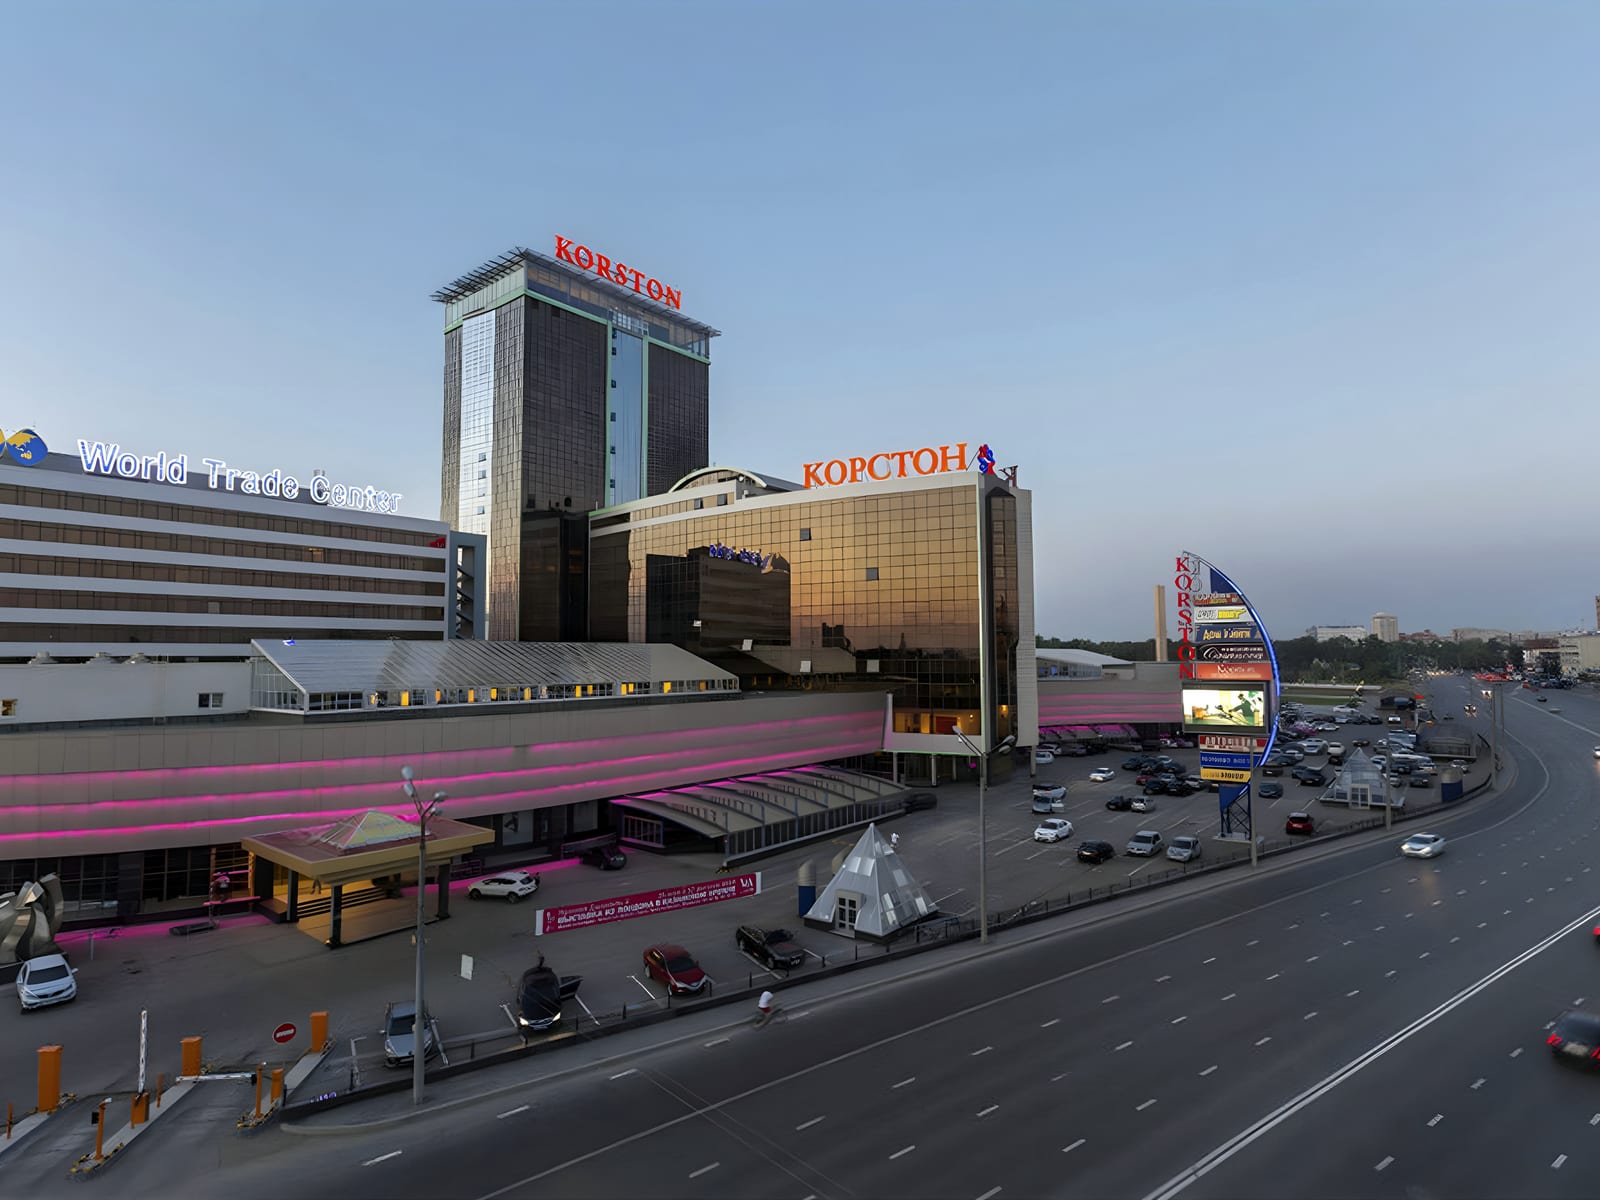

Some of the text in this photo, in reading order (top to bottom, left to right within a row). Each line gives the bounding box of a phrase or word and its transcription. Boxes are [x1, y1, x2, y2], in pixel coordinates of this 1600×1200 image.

[555, 233, 682, 310] KORSTON
[76, 438, 403, 514] World Trade Center
[803, 443, 968, 489] КОРСТОН
[1175, 556, 1195, 680] KORSTON
